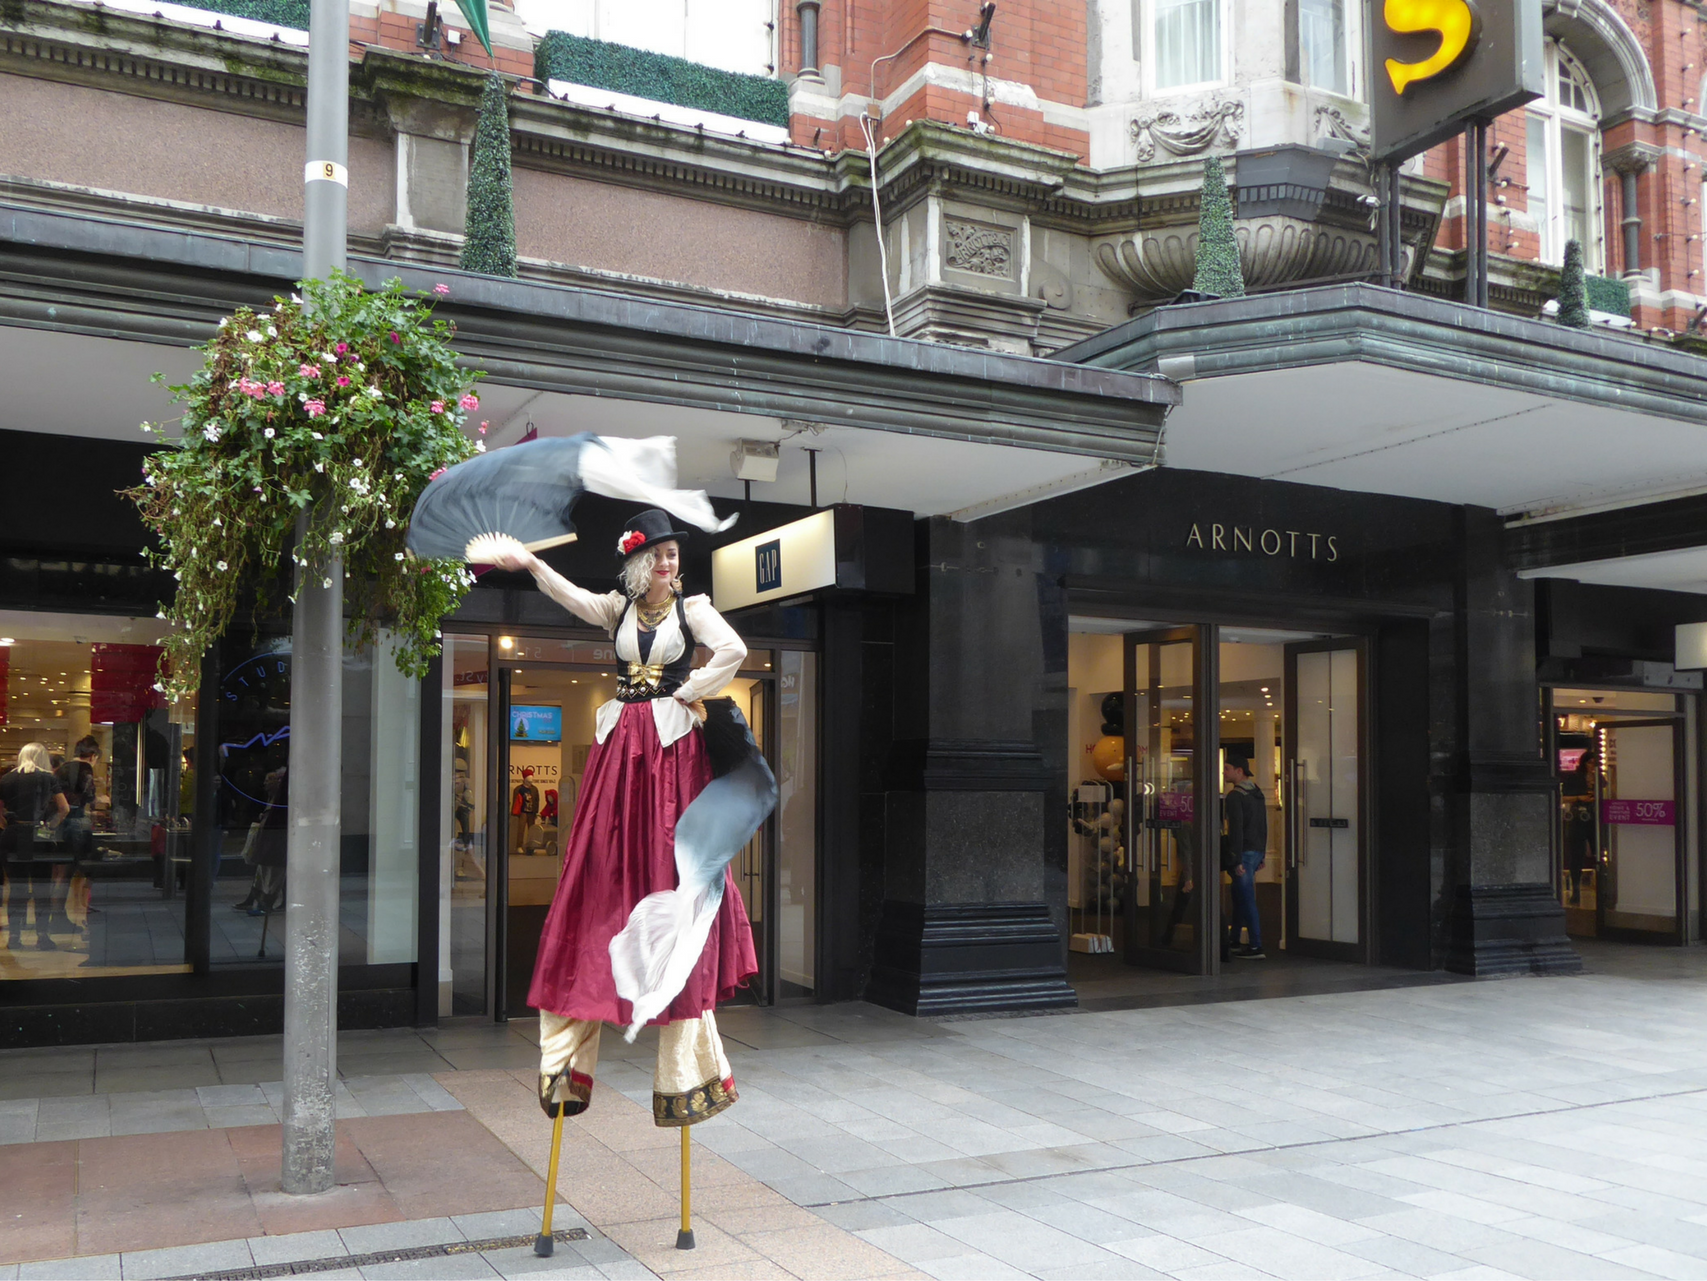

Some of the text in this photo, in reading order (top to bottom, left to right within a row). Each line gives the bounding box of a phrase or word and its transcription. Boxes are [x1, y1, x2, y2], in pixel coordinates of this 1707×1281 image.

[325, 163, 333, 177] 9
[1186, 523, 1337, 562] ARNOTTS
[759, 549, 777, 584] GAP
[225, 661, 286, 701] STUD
[509, 765, 558, 776] RNOTTS
[1180, 795, 1194, 812] 50
[1636, 803, 1666, 818] 50%
